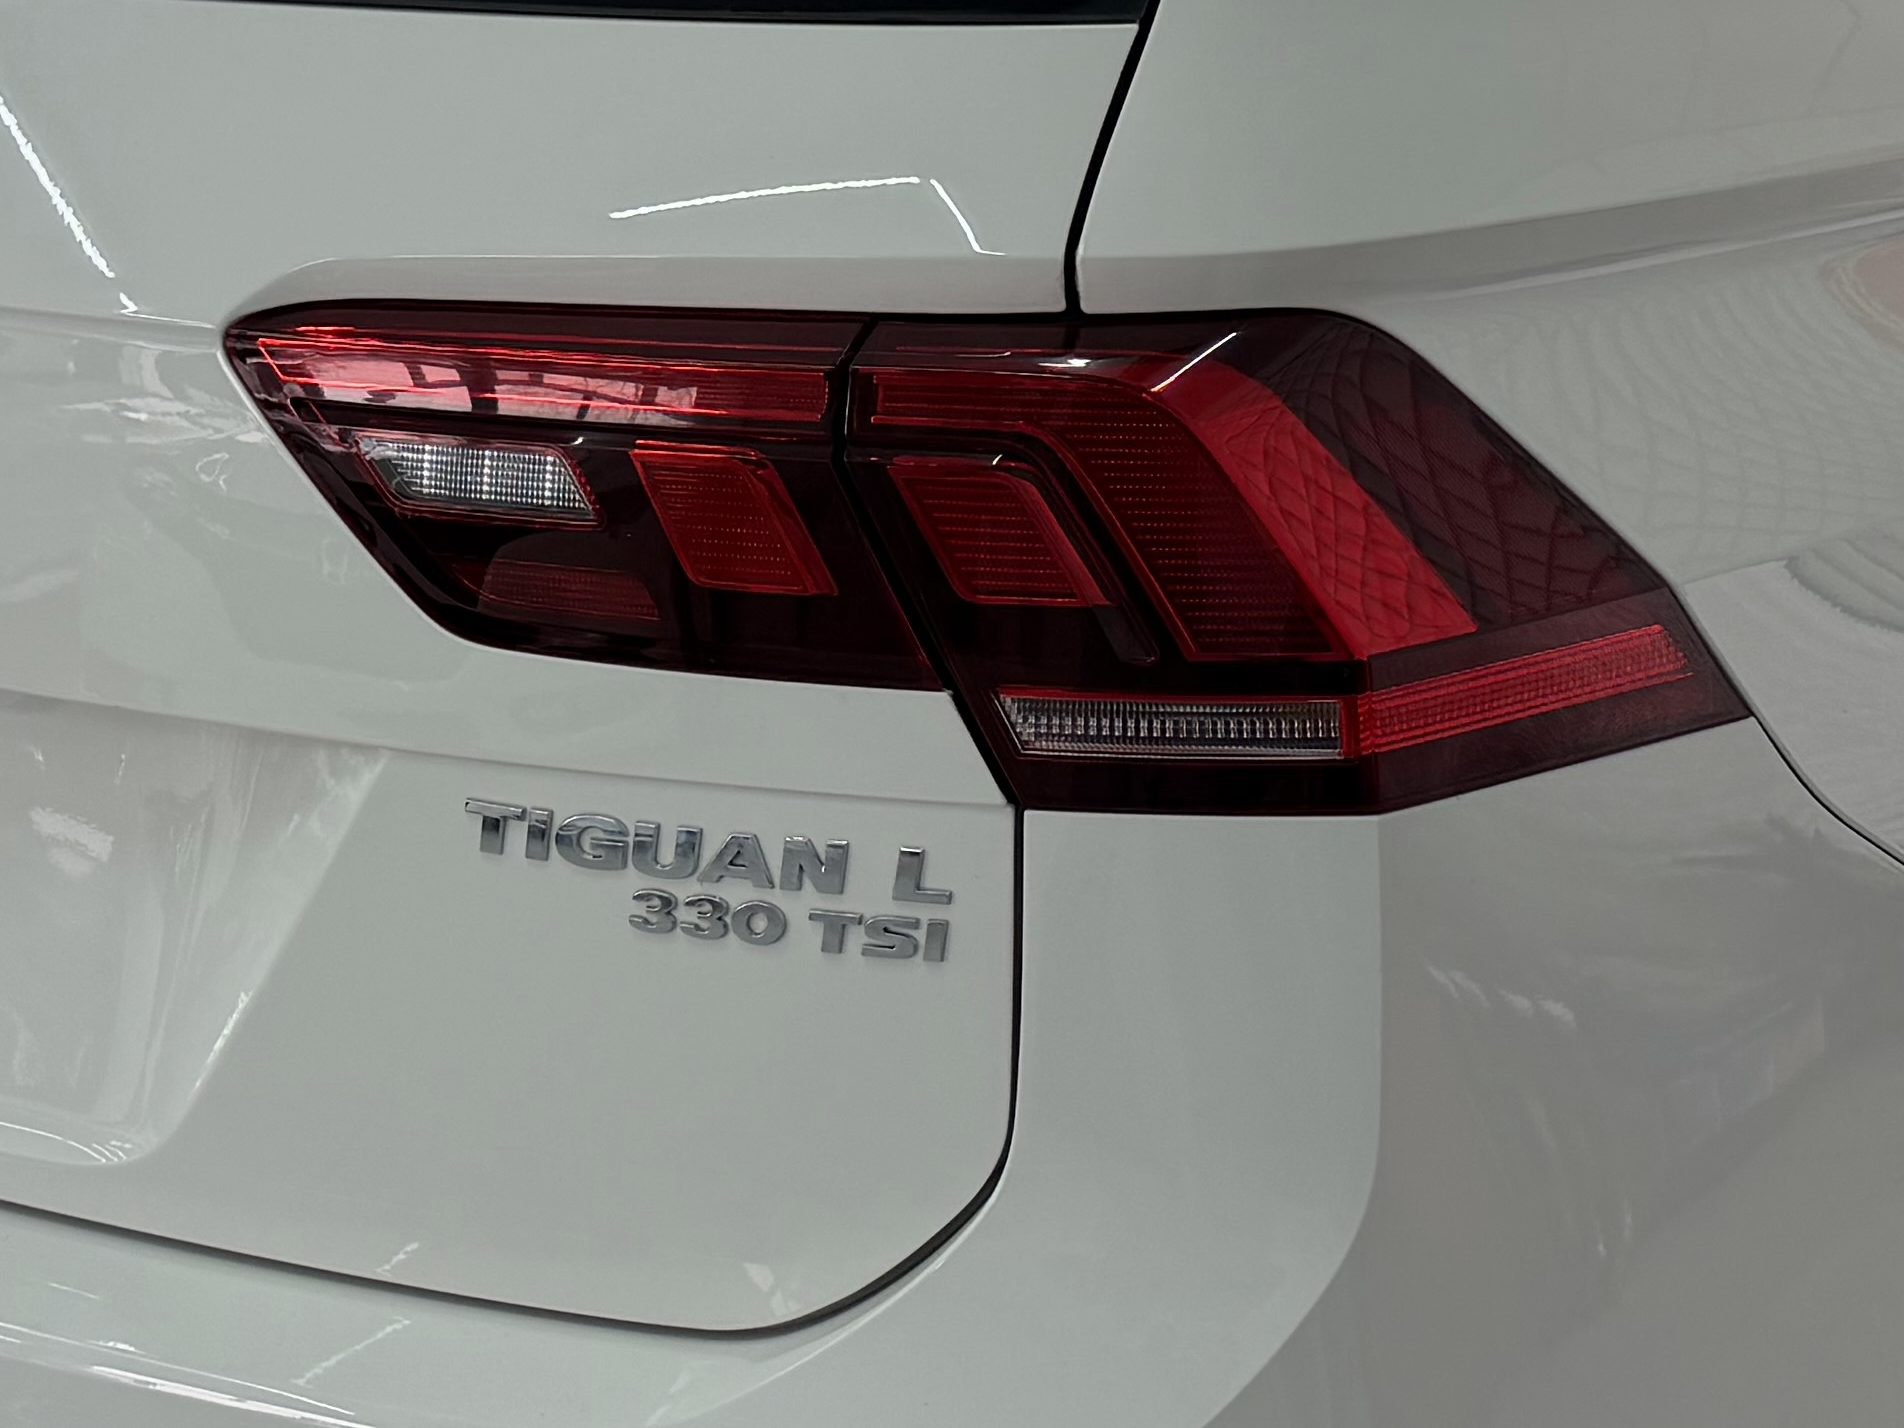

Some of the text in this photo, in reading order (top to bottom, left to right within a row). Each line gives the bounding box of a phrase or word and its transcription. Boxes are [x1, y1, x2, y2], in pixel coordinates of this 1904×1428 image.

[464, 797, 954, 906] TIGUAN L
[628, 888, 951, 963] 330 TSI
